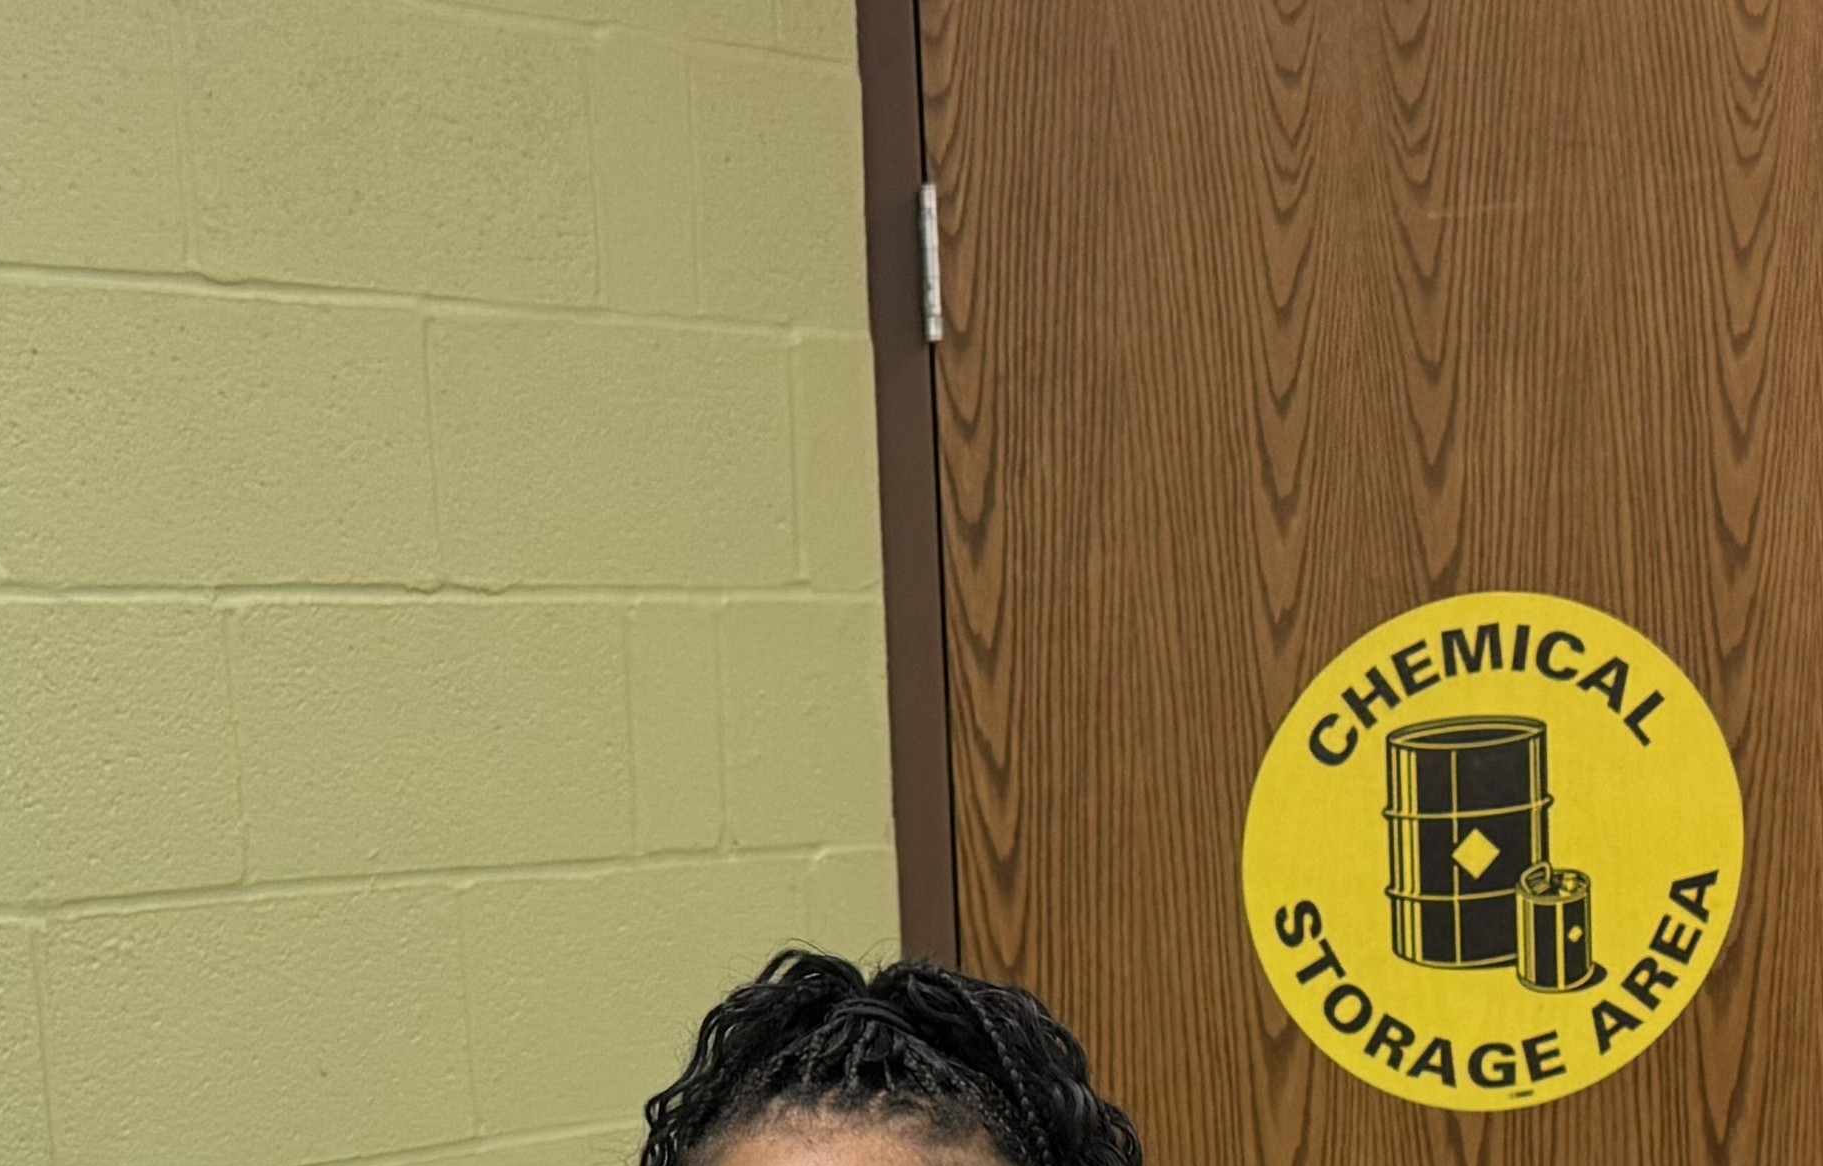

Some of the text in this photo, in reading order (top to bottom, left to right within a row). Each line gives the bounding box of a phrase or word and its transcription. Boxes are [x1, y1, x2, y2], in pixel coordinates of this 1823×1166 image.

[1308, 622, 1666, 767] CHEMICAL
[1274, 868, 1720, 1088] STORAGE AREA
